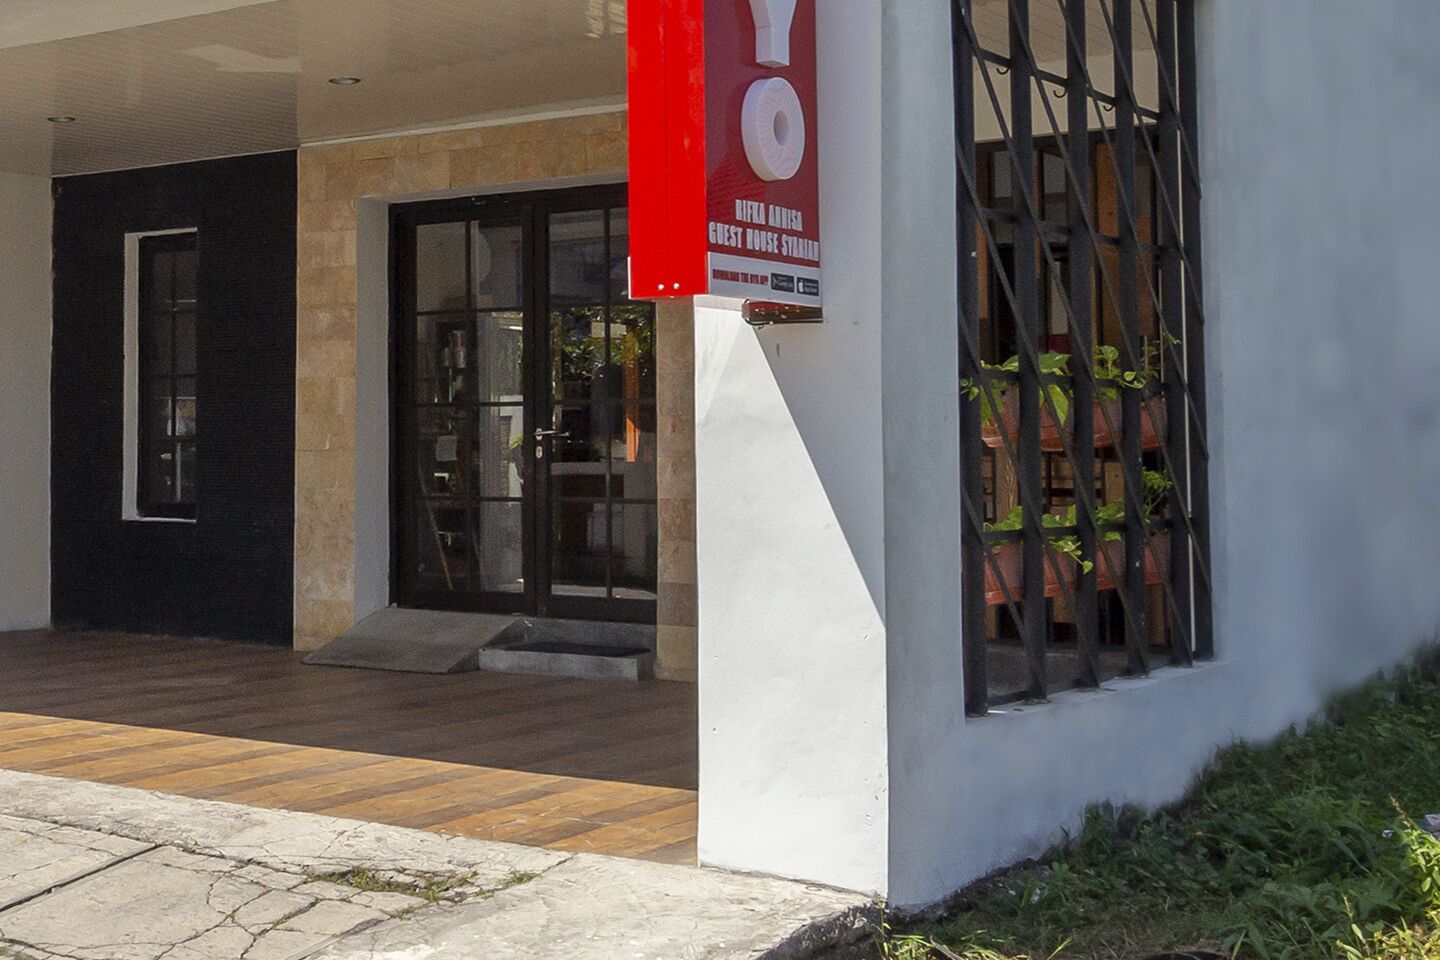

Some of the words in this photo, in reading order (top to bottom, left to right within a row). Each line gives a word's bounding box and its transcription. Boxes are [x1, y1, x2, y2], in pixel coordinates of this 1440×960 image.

[735, 199, 766, 225] RIFKA
[768, 204, 803, 232] ANNISA
[708, 221, 743, 248] GUEST
[746, 228, 779, 254] HOUSE
